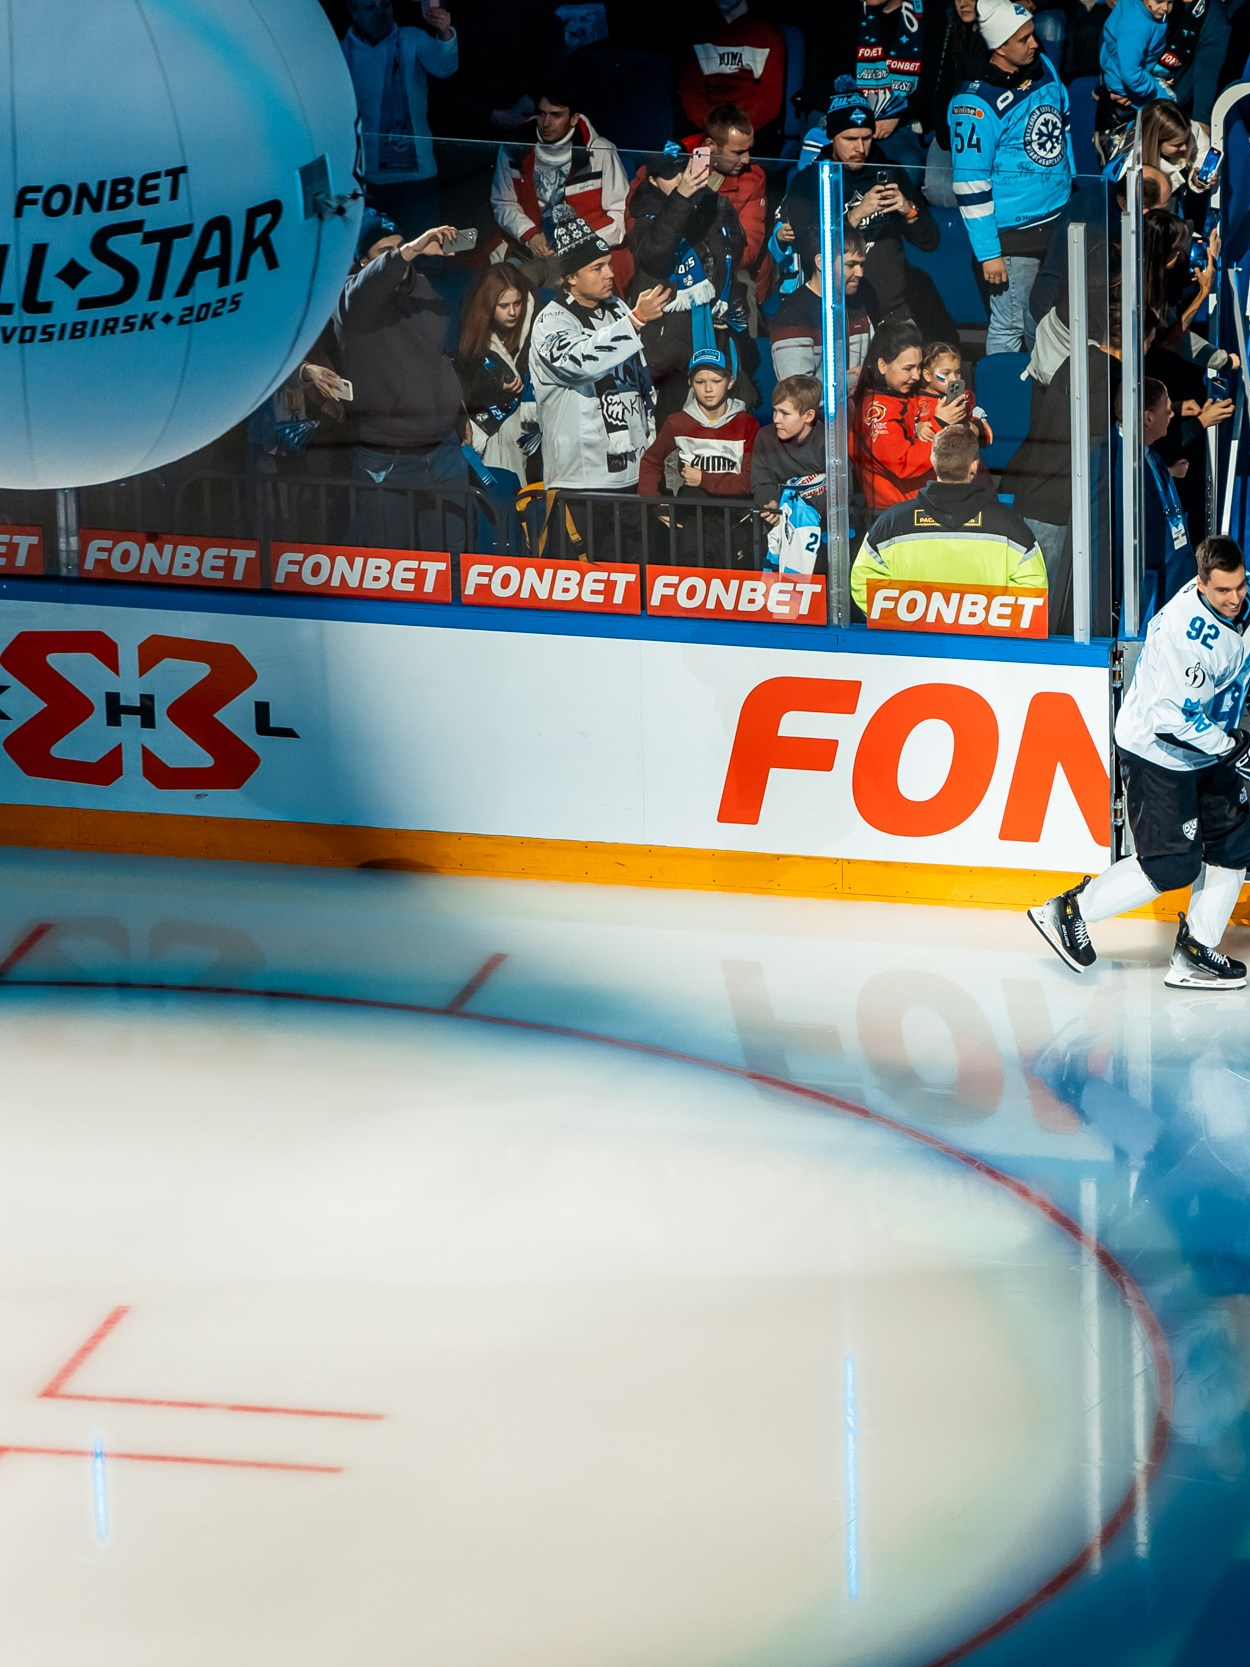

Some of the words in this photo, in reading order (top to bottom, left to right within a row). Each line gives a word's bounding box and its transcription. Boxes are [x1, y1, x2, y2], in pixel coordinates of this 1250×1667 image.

[954, 121, 982, 154] 54
[14, 165, 188, 219] FONBET
[84, 539, 257, 581] FONBET
[274, 552, 446, 595] FONBET
[463, 563, 636, 604] FONBET
[650, 575, 822, 614] FONBET
[870, 588, 1044, 629] FONBET
[1186, 616, 1220, 650] 92
